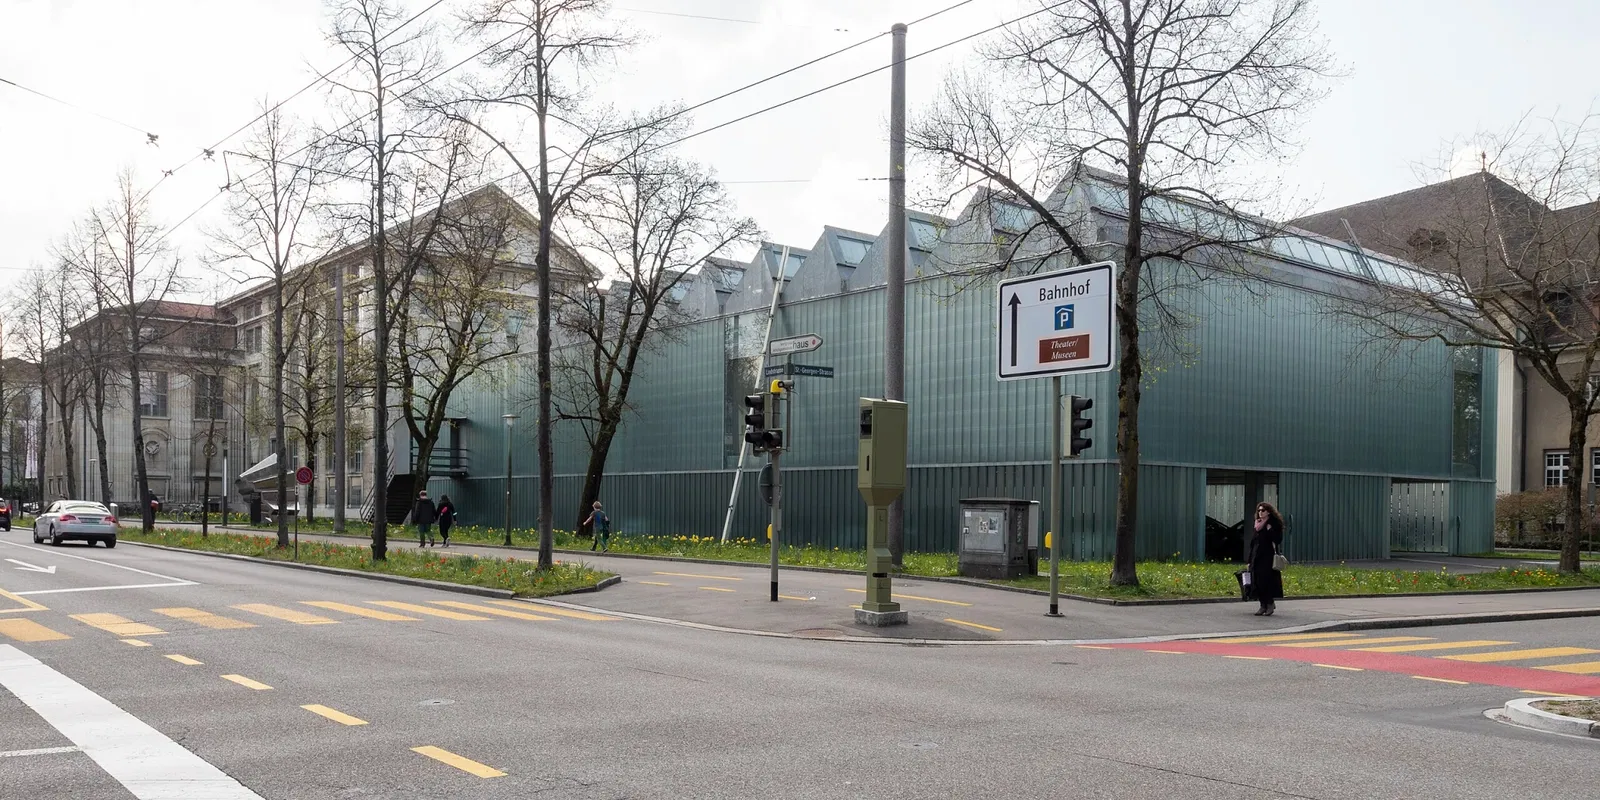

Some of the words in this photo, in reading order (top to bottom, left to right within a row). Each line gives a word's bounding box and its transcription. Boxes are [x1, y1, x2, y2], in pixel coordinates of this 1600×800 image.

[1039, 279, 1090, 302] Bahnhof
[1060, 312, 1069, 327] P
[793, 341, 809, 350] haus
[1051, 338, 1078, 349] Theater/
[1051, 350, 1077, 360] Museen
